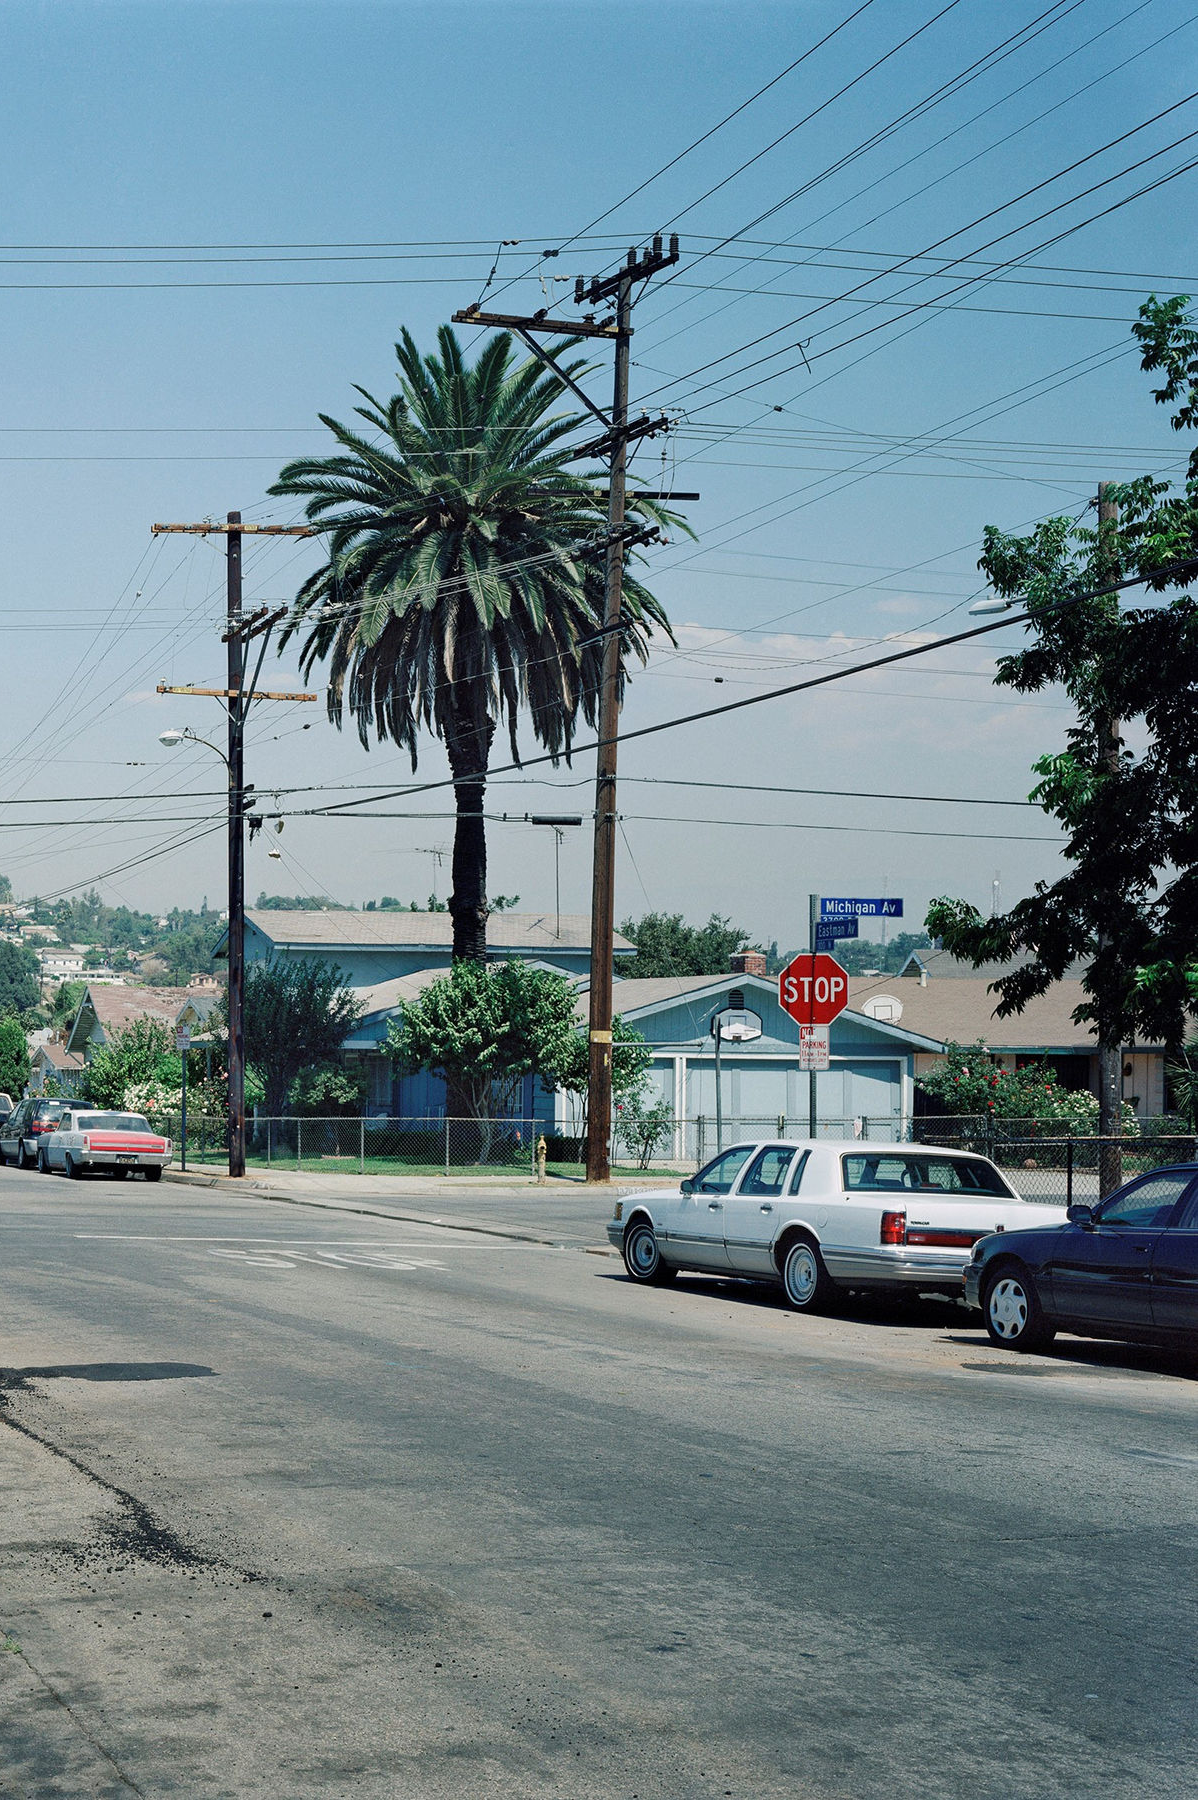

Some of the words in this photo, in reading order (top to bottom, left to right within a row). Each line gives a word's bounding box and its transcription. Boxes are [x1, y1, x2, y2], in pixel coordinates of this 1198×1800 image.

[826, 900, 876, 915] Michigan
[882, 901, 896, 913] Av
[818, 924, 845, 937] Eastman
[848, 922, 856, 935] Av
[784, 977, 844, 1003] STOP
[802, 1040, 827, 1049] PARKING
[206, 1248, 453, 1271] STOP
